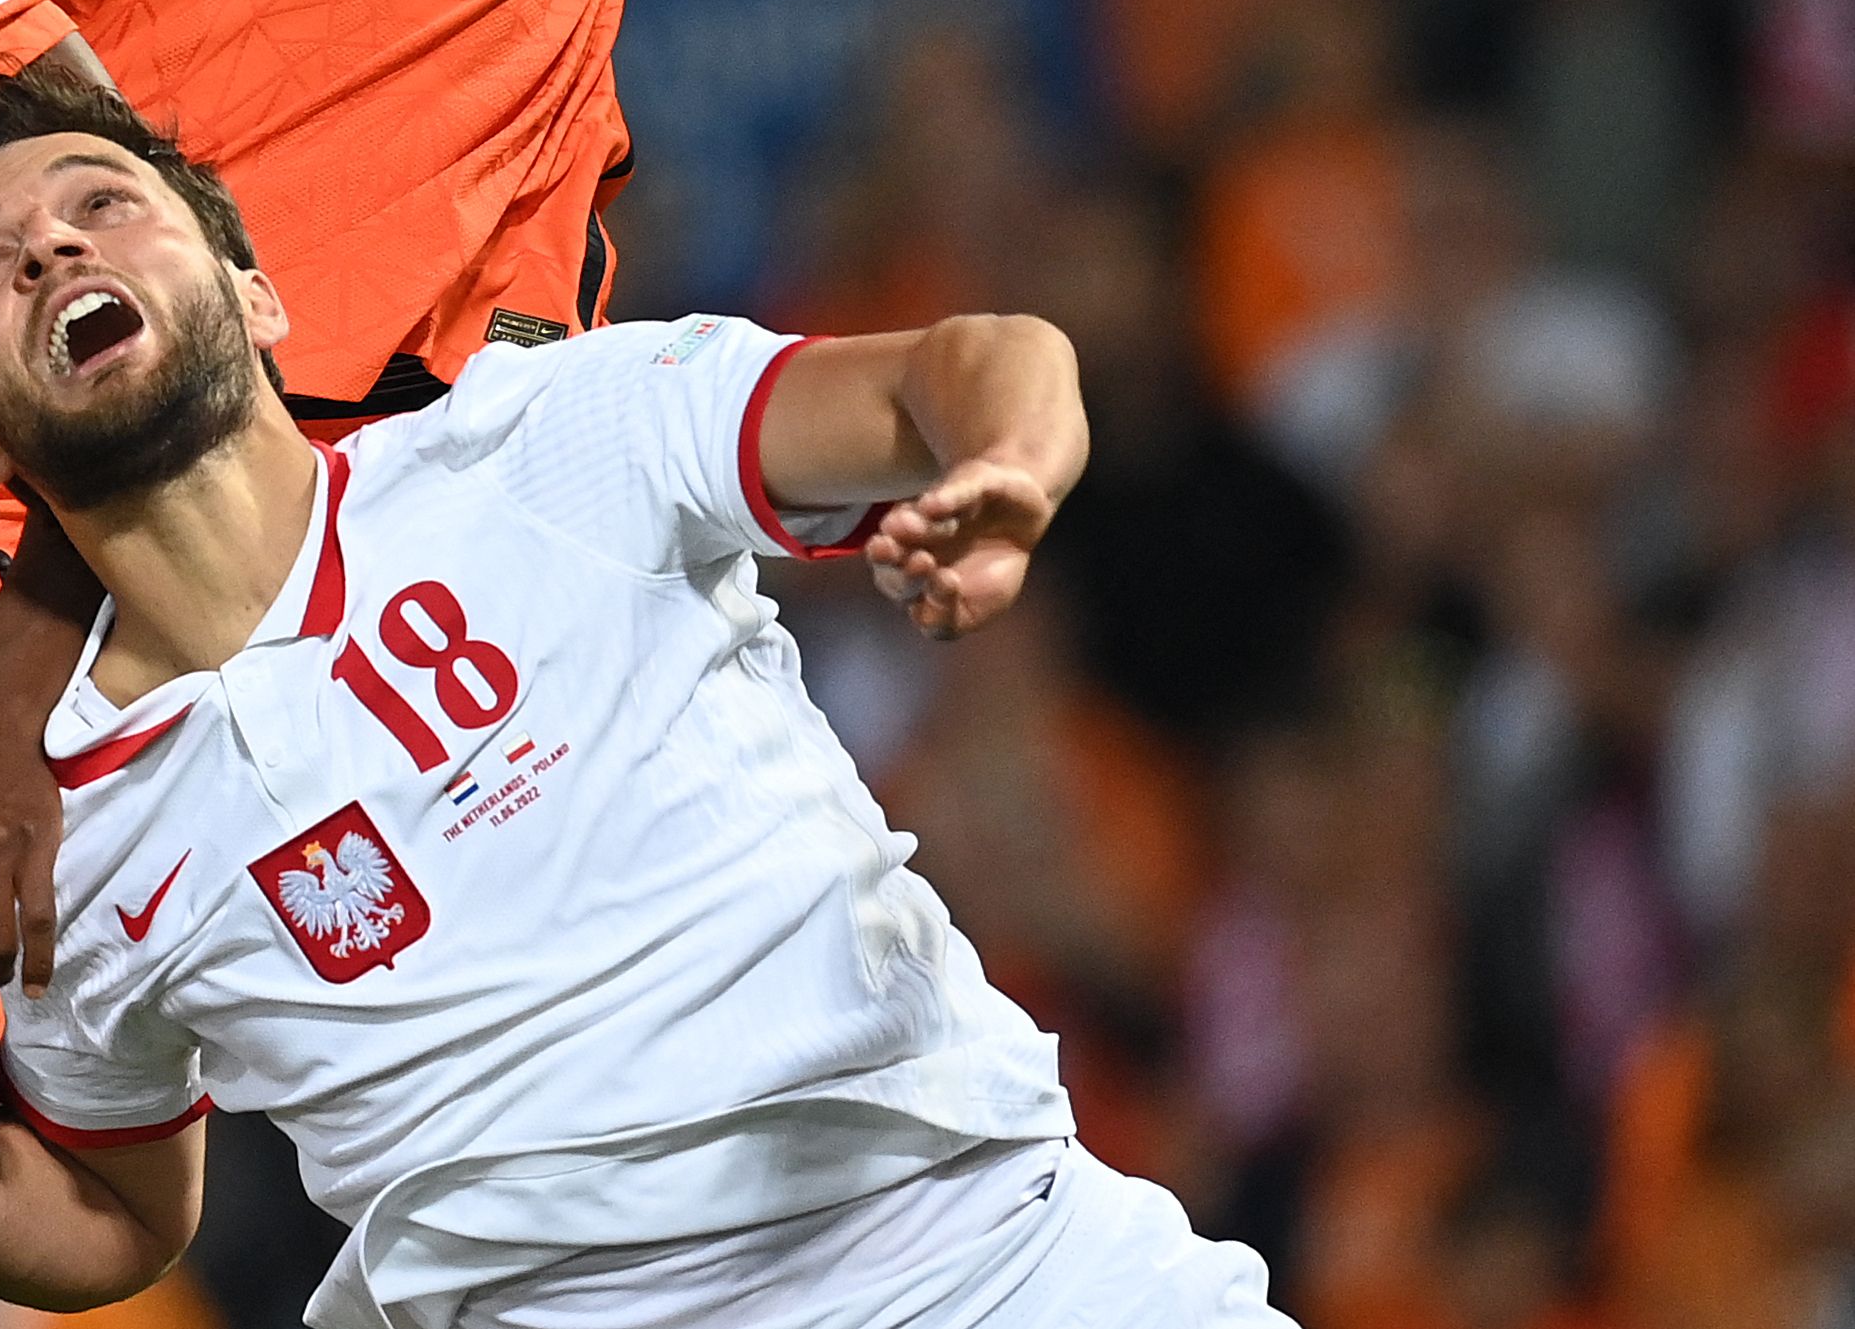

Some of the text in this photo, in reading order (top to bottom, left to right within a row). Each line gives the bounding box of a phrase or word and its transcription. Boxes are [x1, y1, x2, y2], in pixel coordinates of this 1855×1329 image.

[331, 580, 518, 774] 18
[442, 822, 463, 842] THE
[461, 774, 526, 828] NETHERLANDS
[532, 743, 570, 775] POLAND
[489, 786, 541, 827] 11.06.2022
